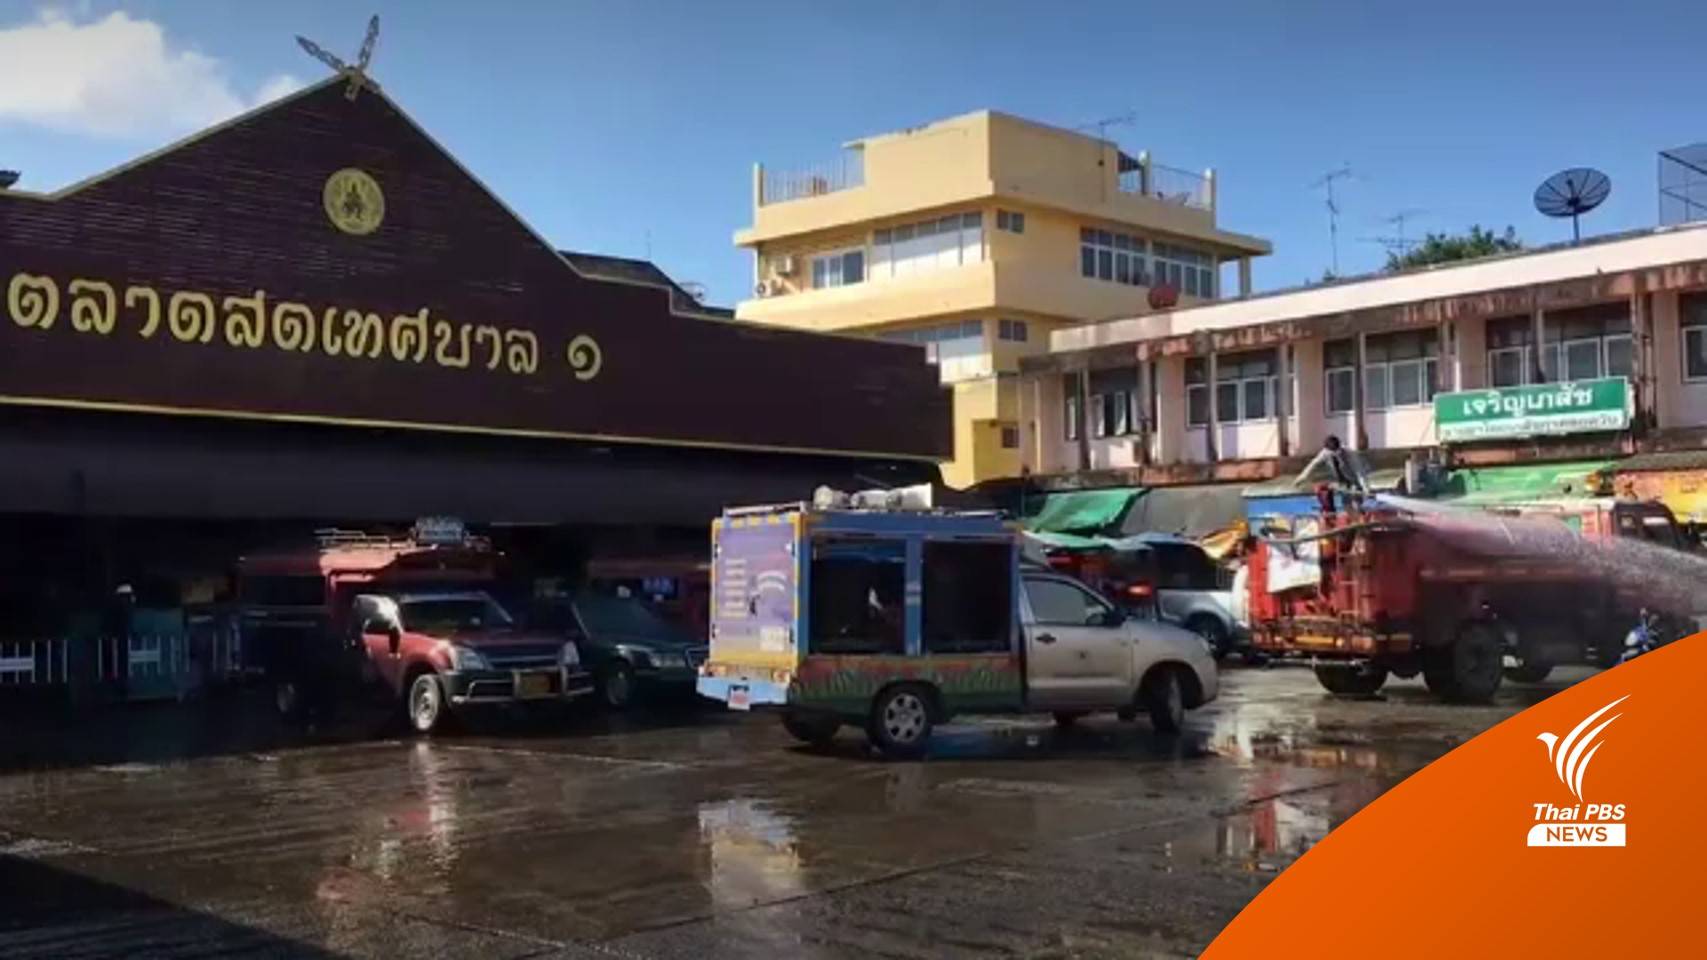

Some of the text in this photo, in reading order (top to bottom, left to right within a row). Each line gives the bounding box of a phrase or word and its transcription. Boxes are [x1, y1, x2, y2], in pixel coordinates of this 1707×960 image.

[7, 272, 602, 380] ตลาดสดเทศบาล ๑
